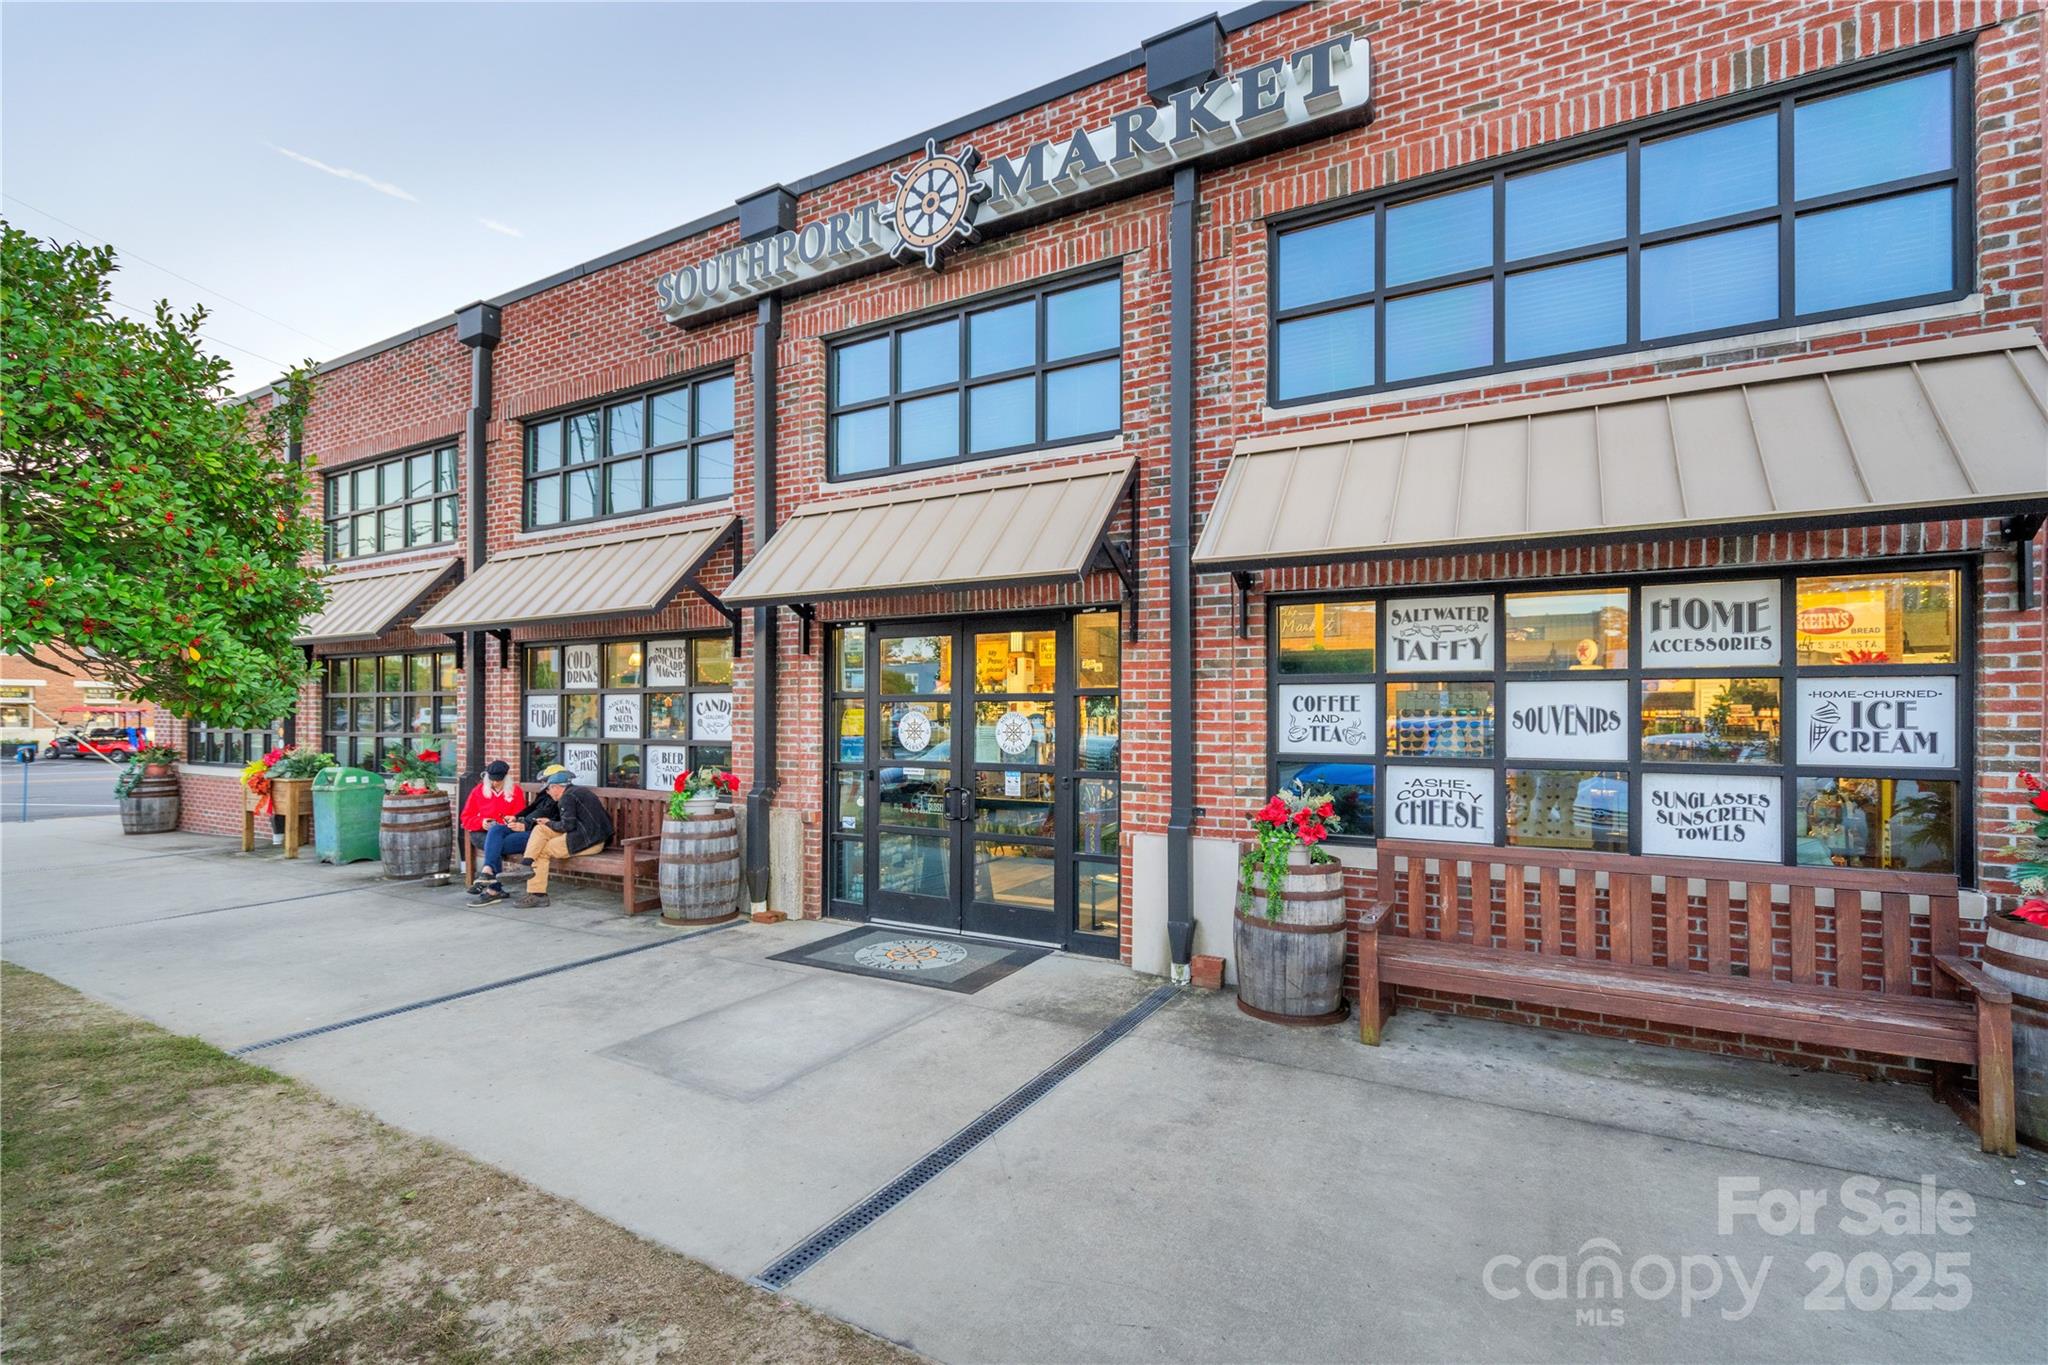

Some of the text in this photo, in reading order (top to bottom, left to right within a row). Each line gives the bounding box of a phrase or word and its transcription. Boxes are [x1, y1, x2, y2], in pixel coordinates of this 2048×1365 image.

[657, 33, 1354, 311] SOUTHPORT MARKET
[1391, 606, 1489, 626] SALTWATER
[1650, 597, 1771, 635] HOME
[1281, 619, 1335, 632] Markt
[1850, 627, 1881, 635] BREAD
[1392, 634, 1488, 661] TAFFY
[1648, 635, 1772, 653] ACCESSORIES
[567, 651, 591, 669] COLD
[567, 670, 598, 683] DRINKS
[696, 699, 732, 715] CANDY
[1292, 695, 1361, 712] COFFEE
[531, 709, 556, 728] FUDGE
[1512, 704, 1621, 736] SOUVENIRS
[1851, 700, 1919, 730] ICE
[1309, 725, 1343, 742] TEA
[1829, 730, 1938, 753] CREAM
[580, 759, 599, 771] HATS
[661, 751, 684, 765] BEER
[1397, 789, 1482, 803] COUNTY
[1652, 790, 1770, 809] SUNGLASSES
[1395, 800, 1484, 829] CHEESE
[1656, 807, 1766, 826] SUNSCREEN
[1676, 824, 1746, 842] TOWELS
